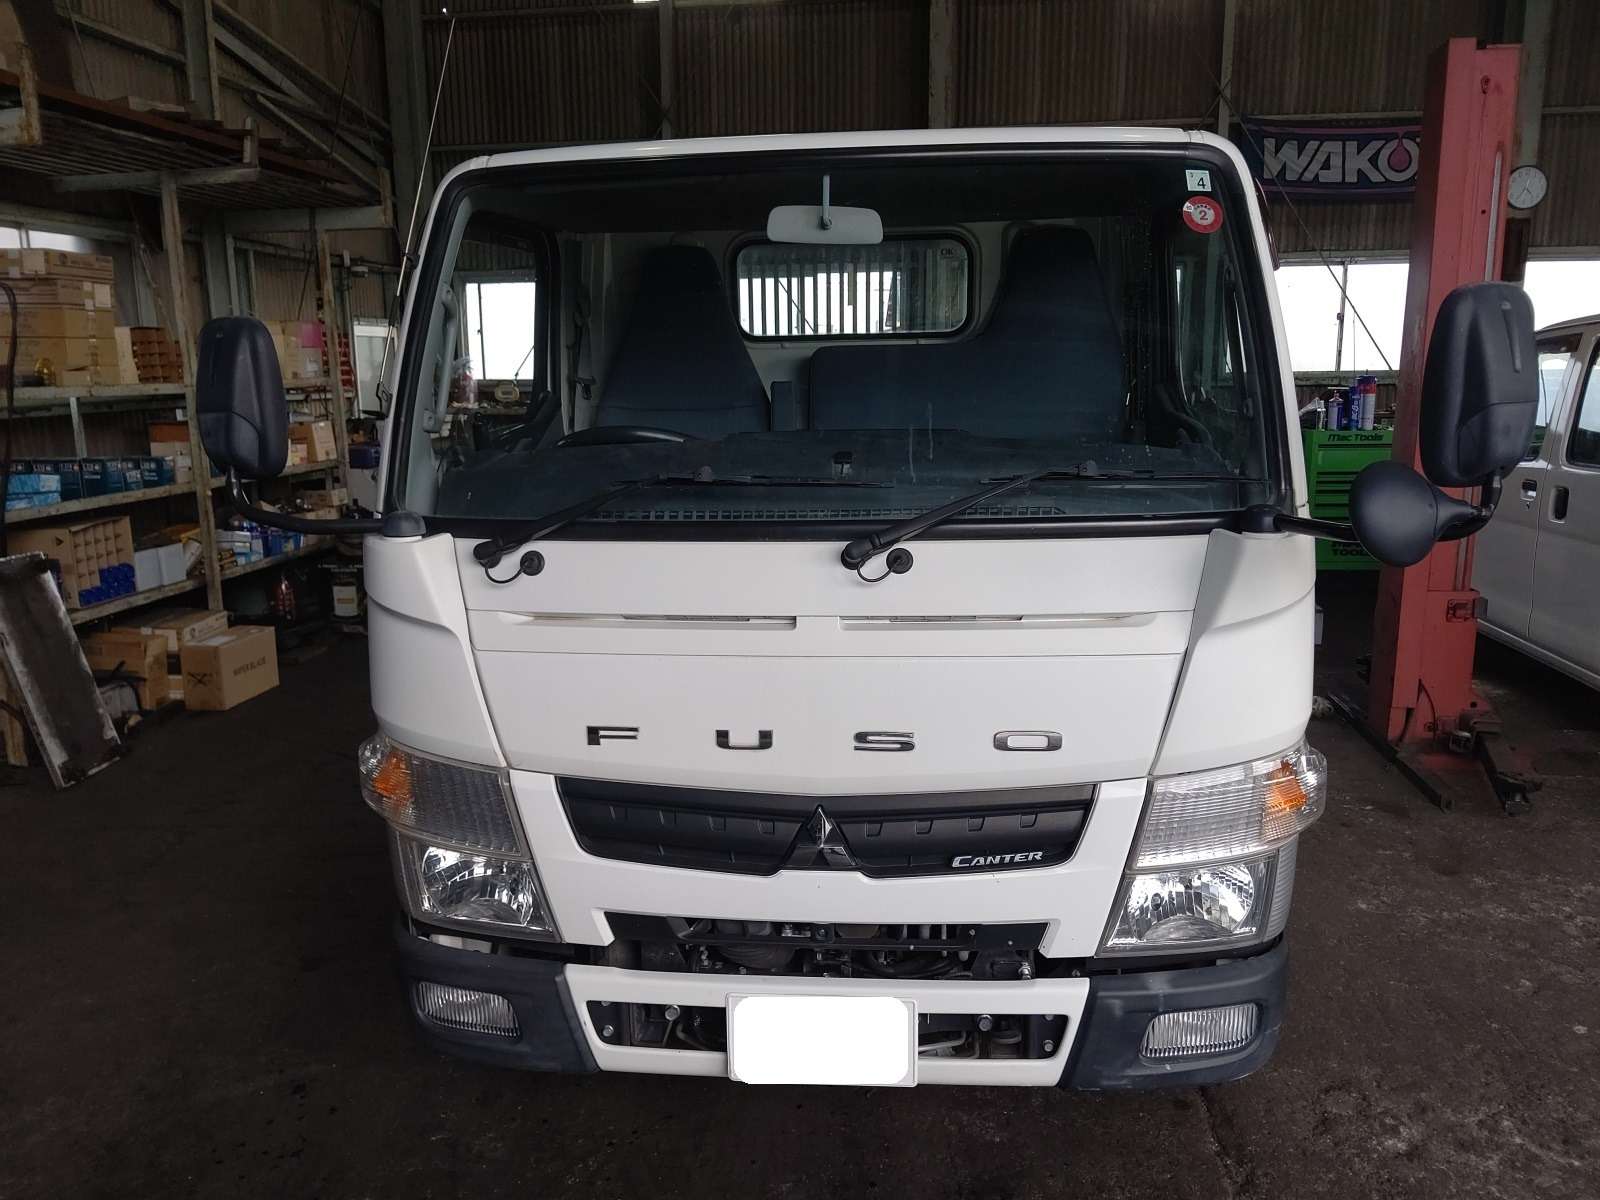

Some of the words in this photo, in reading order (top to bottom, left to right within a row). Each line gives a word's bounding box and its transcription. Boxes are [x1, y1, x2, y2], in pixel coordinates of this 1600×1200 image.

[1263, 137, 1420, 183] WAKO
[1197, 177, 1206, 189] 4
[1199, 210, 1208, 220] 2
[586, 725, 1063, 752] FUSO
[951, 851, 1043, 868] CANTER
